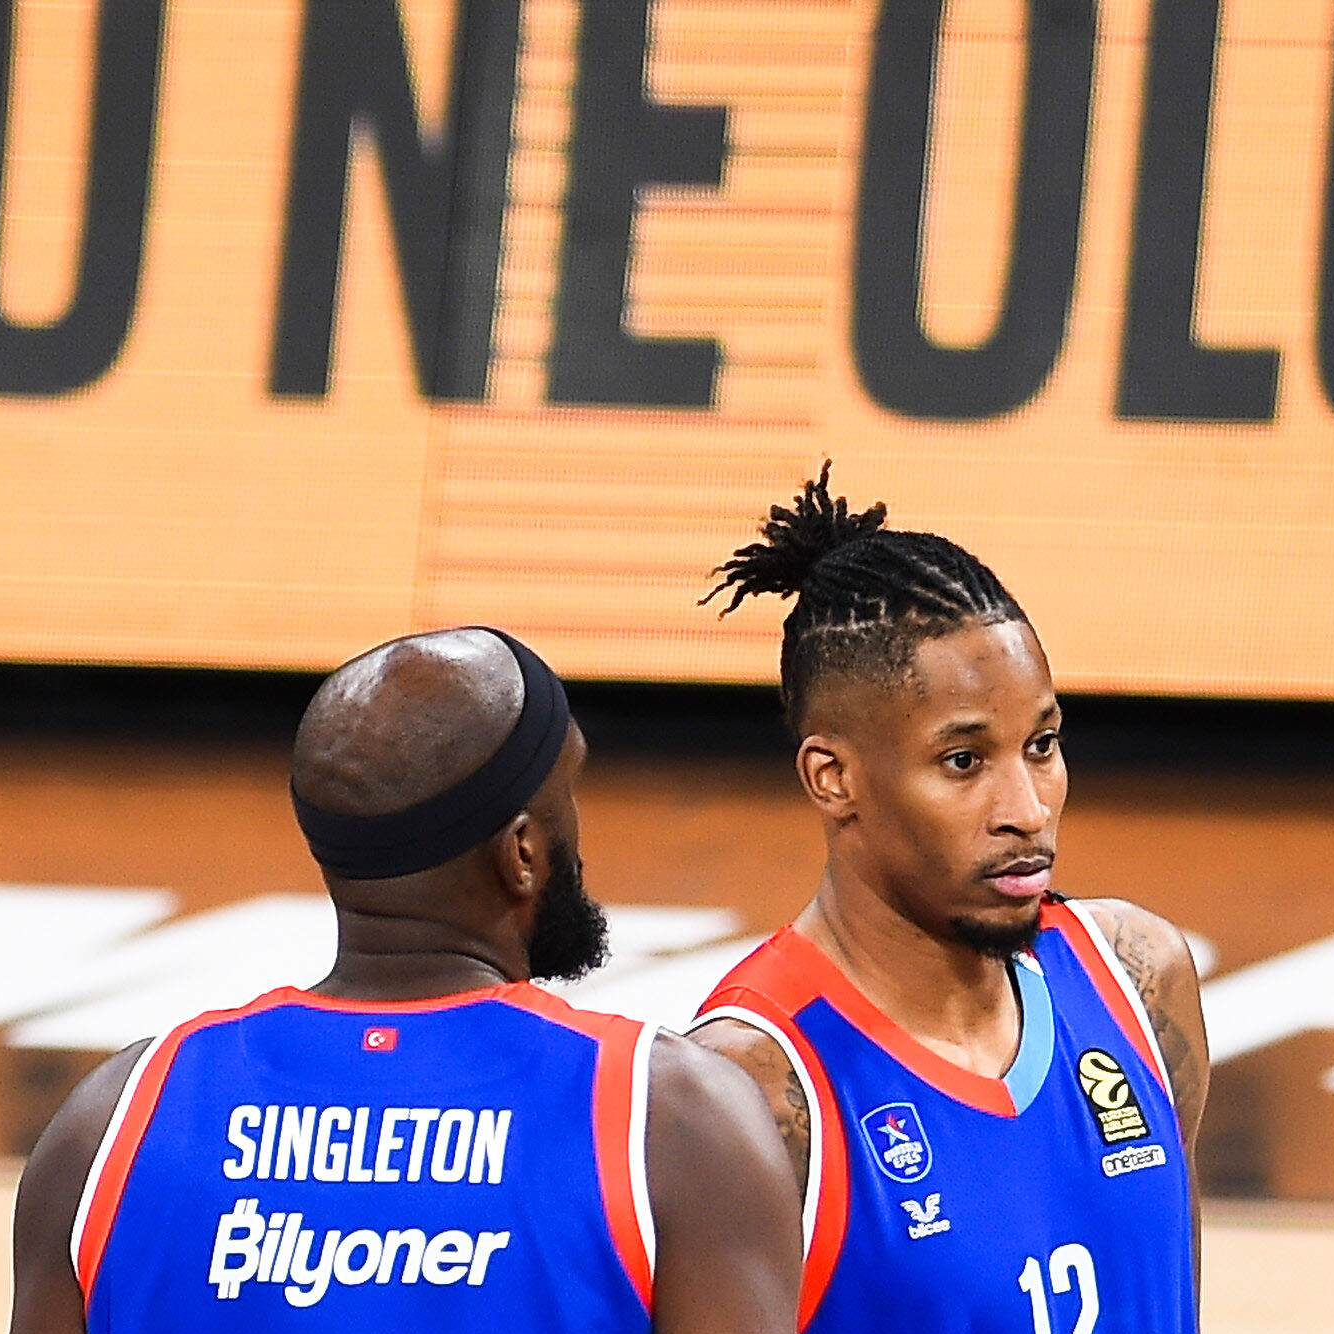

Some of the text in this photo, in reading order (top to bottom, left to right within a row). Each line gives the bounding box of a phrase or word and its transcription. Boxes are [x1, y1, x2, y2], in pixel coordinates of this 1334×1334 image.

[265, 0, 737, 412] NE
[223, 1105, 512, 1184] SINGLETON
[209, 1199, 510, 1307] Bilyoner
